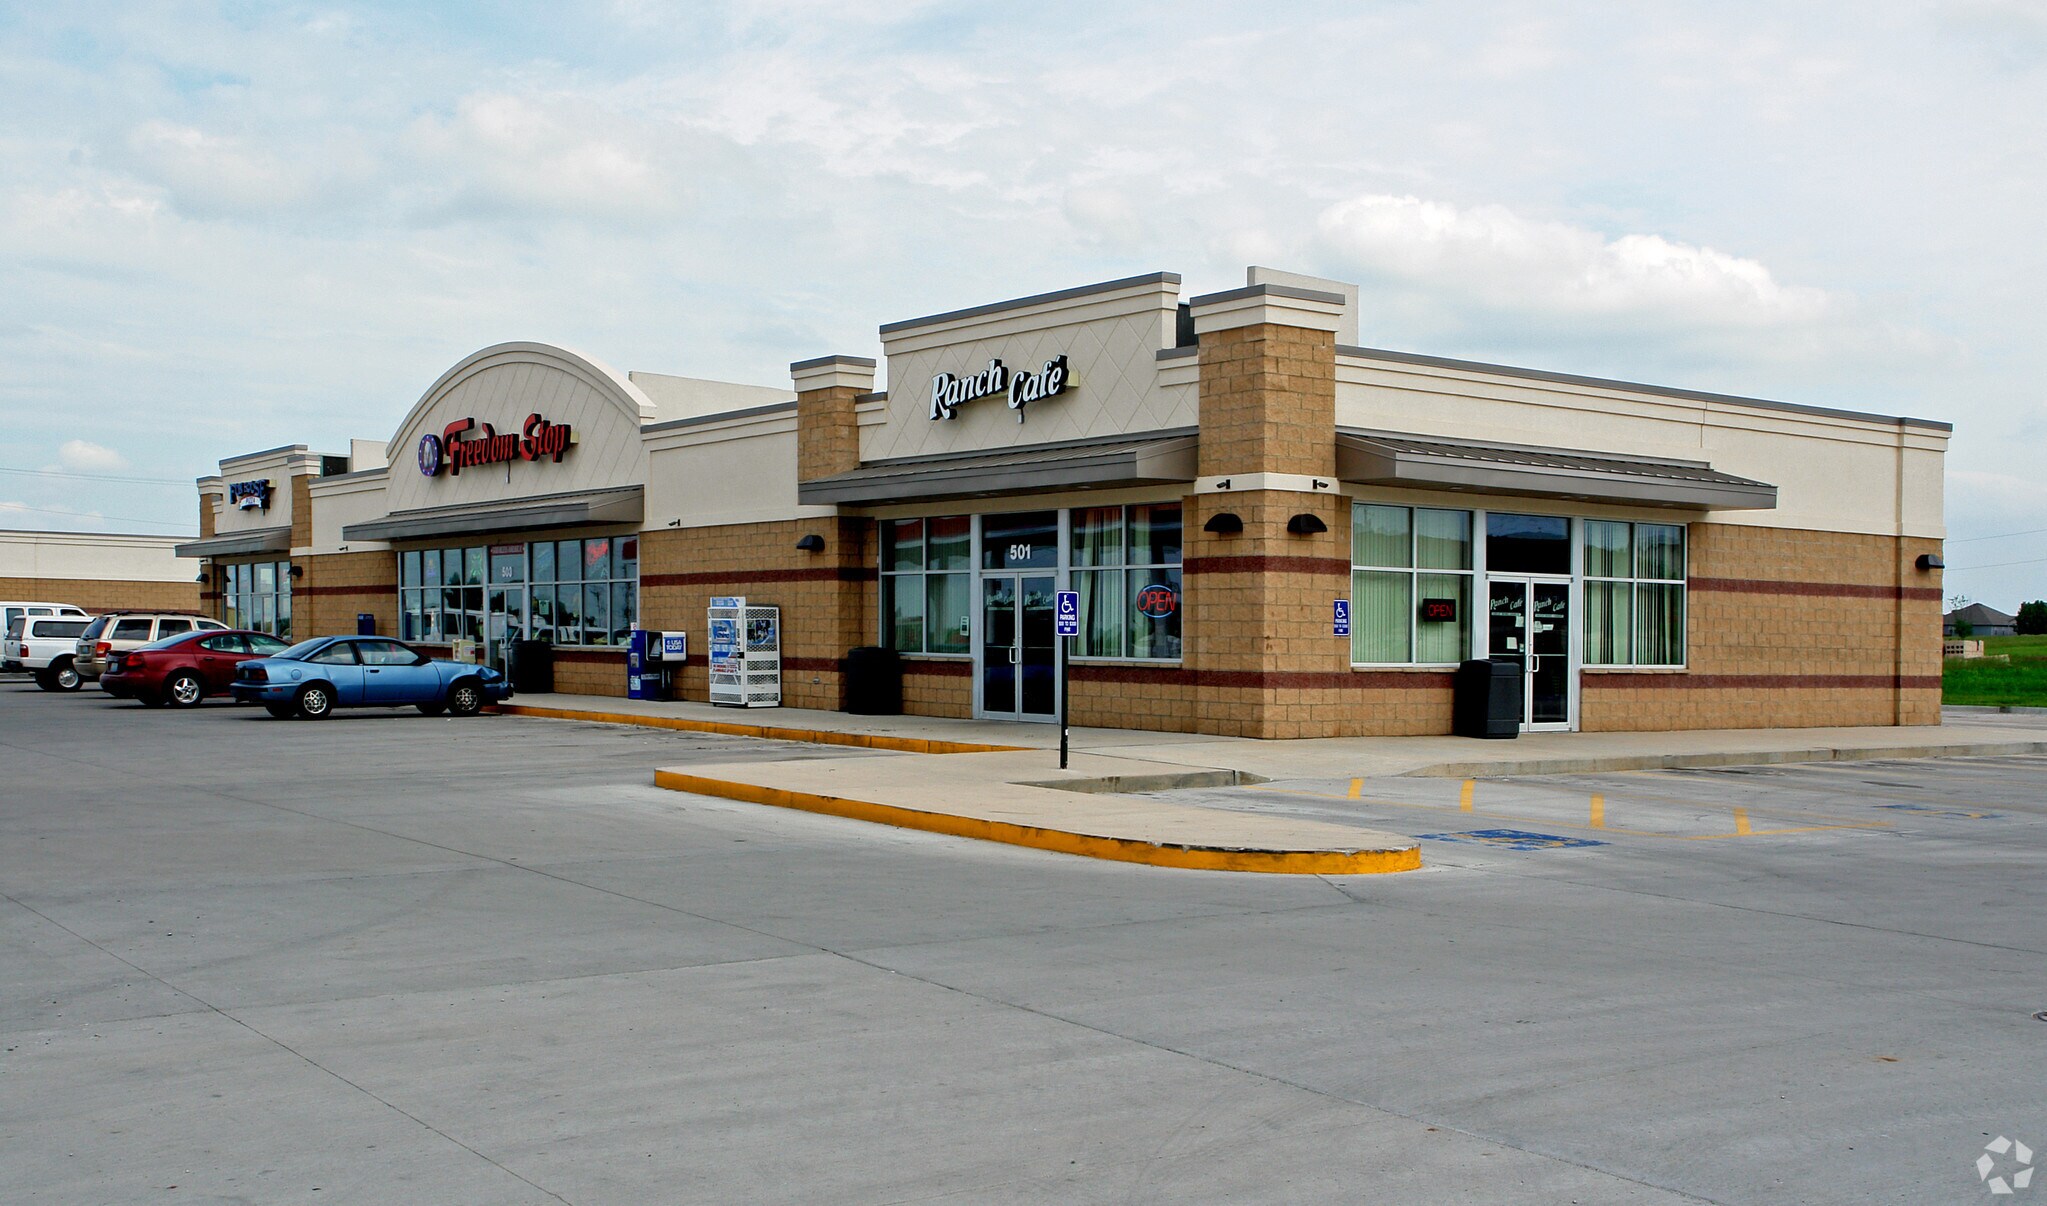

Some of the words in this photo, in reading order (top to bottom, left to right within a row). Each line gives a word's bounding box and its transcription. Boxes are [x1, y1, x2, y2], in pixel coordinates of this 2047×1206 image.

[929, 358, 1006, 420] Ranch
[1008, 355, 1068, 409] Café
[443, 417, 520, 476] Freedom
[519, 413, 572, 463] Stop
[1009, 544, 1032, 560] 501
[502, 566, 513, 578] 503
[1137, 591, 1176, 611] OPEN
[1490, 595, 1509, 610] Ranch
[1534, 597, 1552, 612] Ranch
[1428, 603, 1453, 617] OPEN
